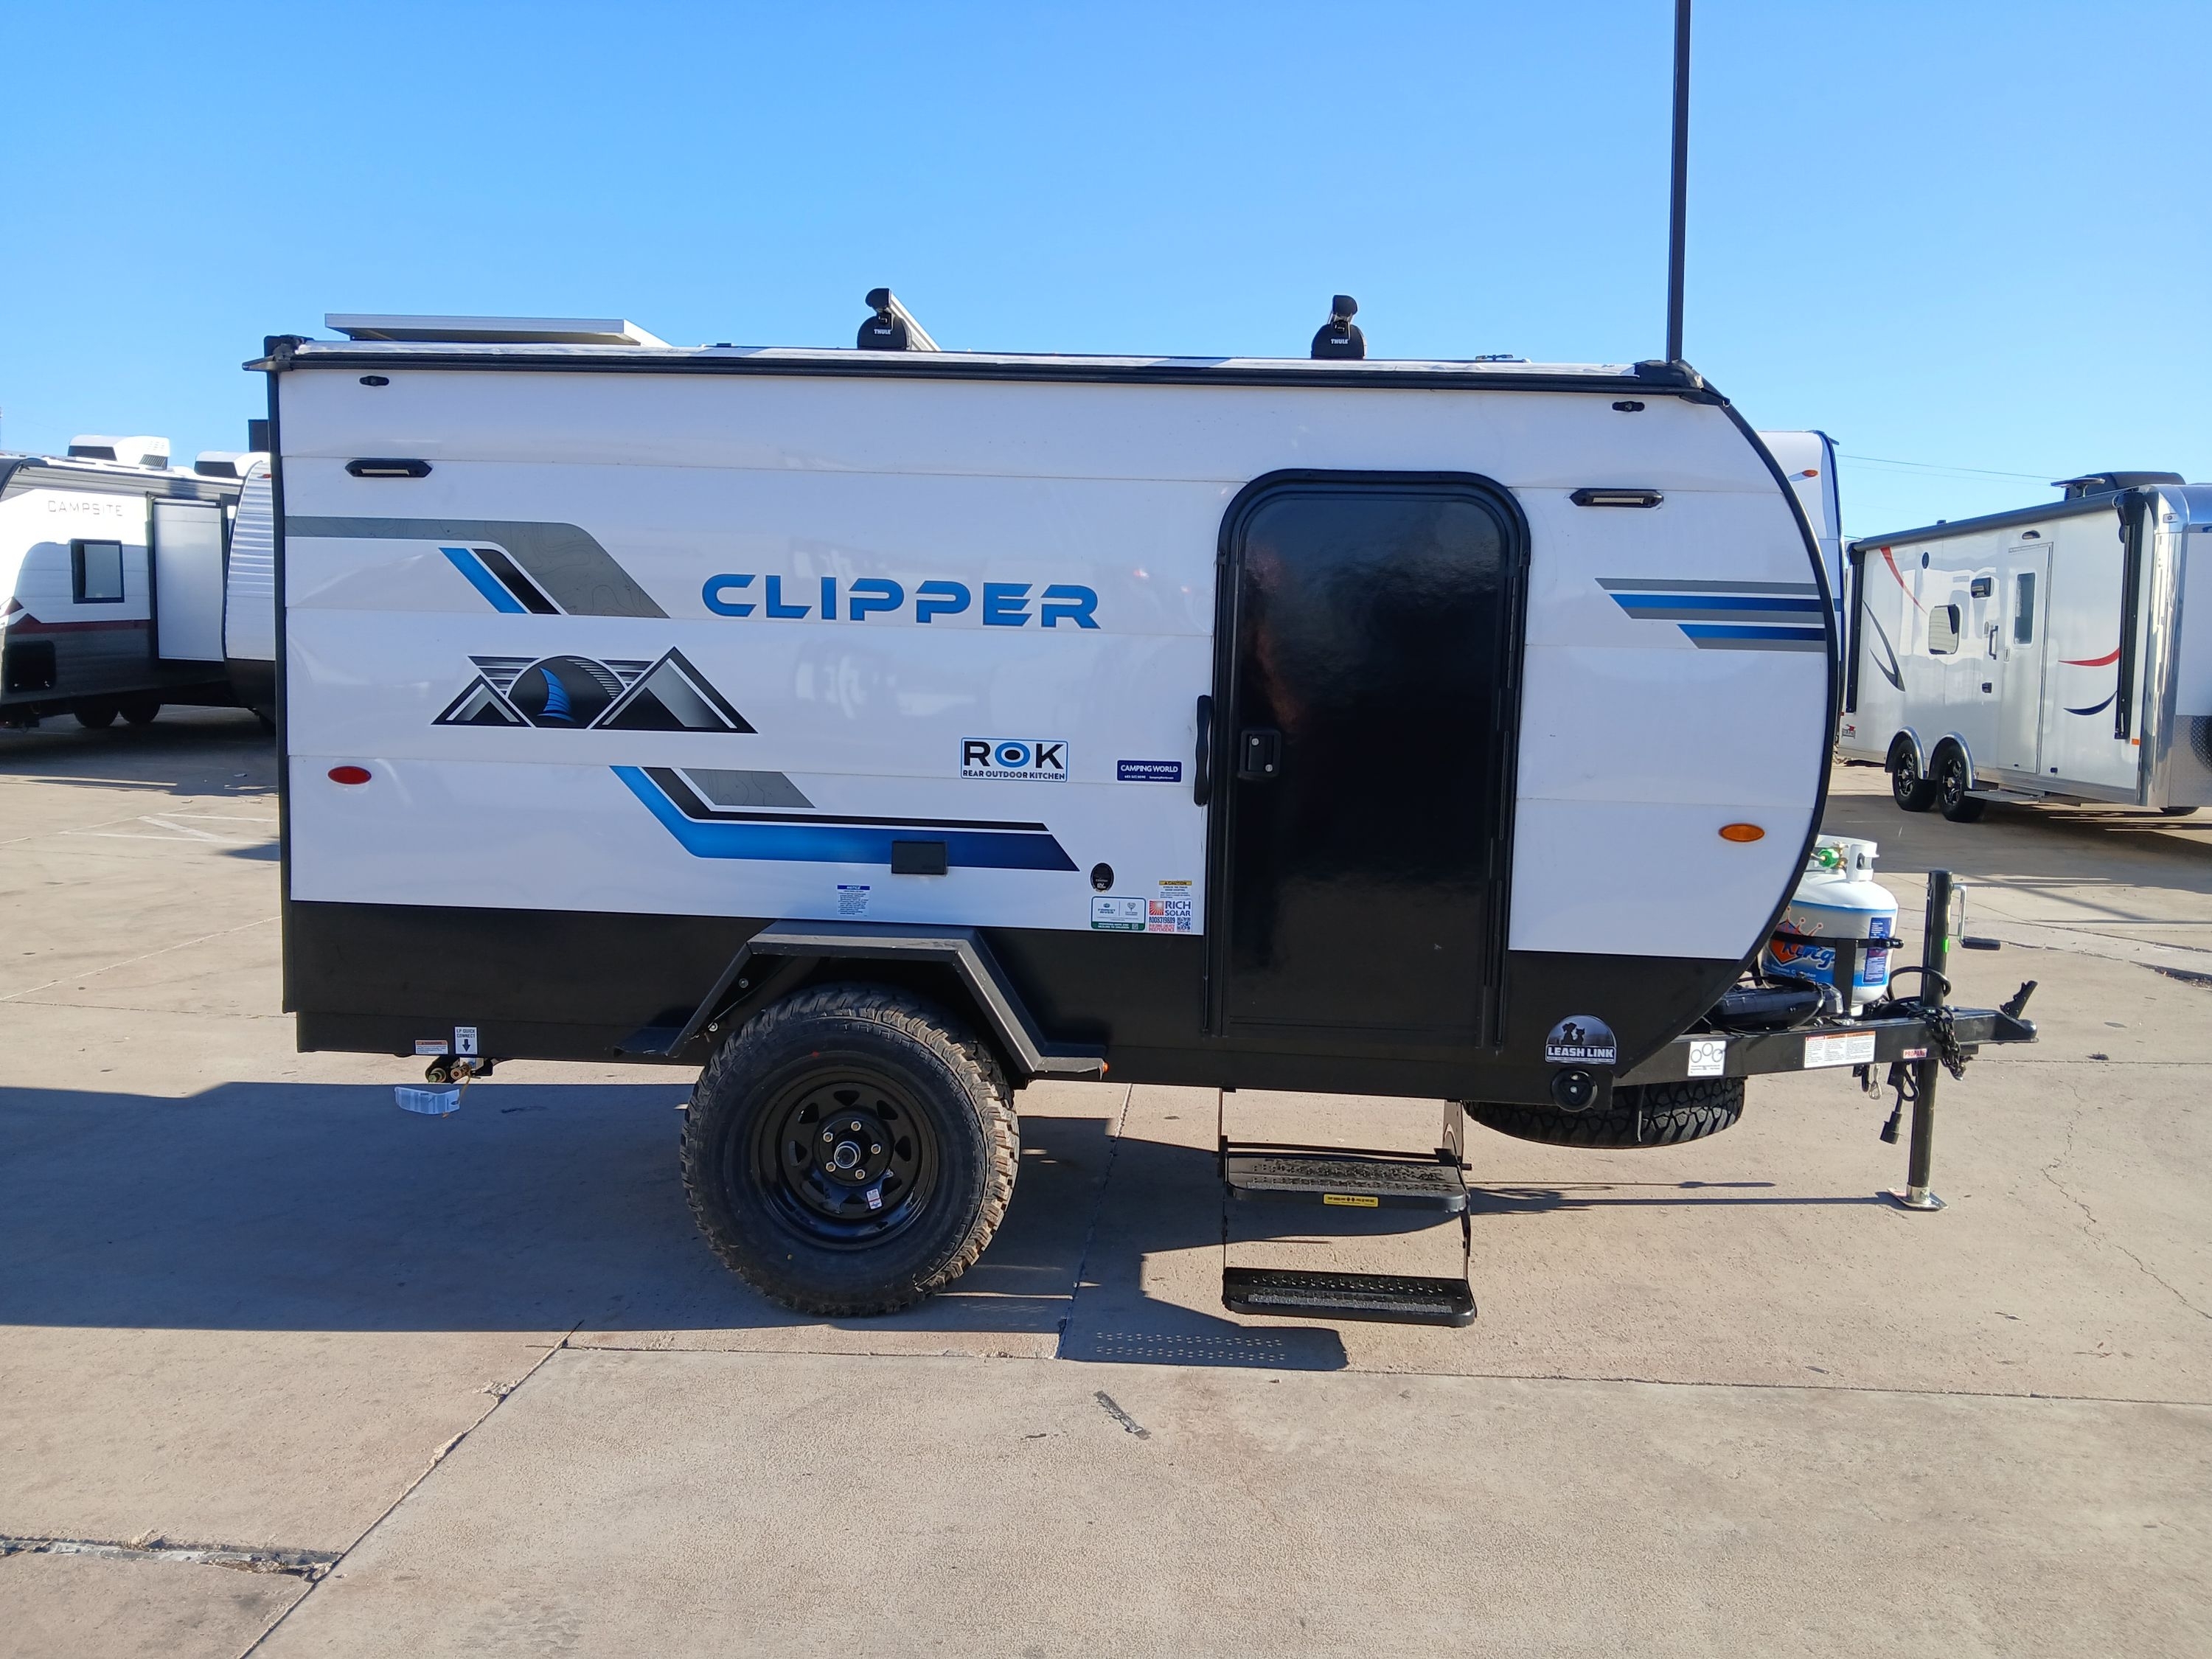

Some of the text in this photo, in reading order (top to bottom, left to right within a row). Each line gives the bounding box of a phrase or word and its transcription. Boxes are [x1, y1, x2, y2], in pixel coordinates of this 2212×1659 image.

[48, 500, 123, 517] CAMPSITE
[701, 573, 1102, 630] CLIPPER
[964, 740, 1064, 770] ROK
[985, 771, 1028, 779] OUTDOOR
[1029, 771, 1065, 780] KITCHEN
[1165, 900, 1192, 910] RICH
[1548, 1046, 1614, 1058] LEASH LINK
